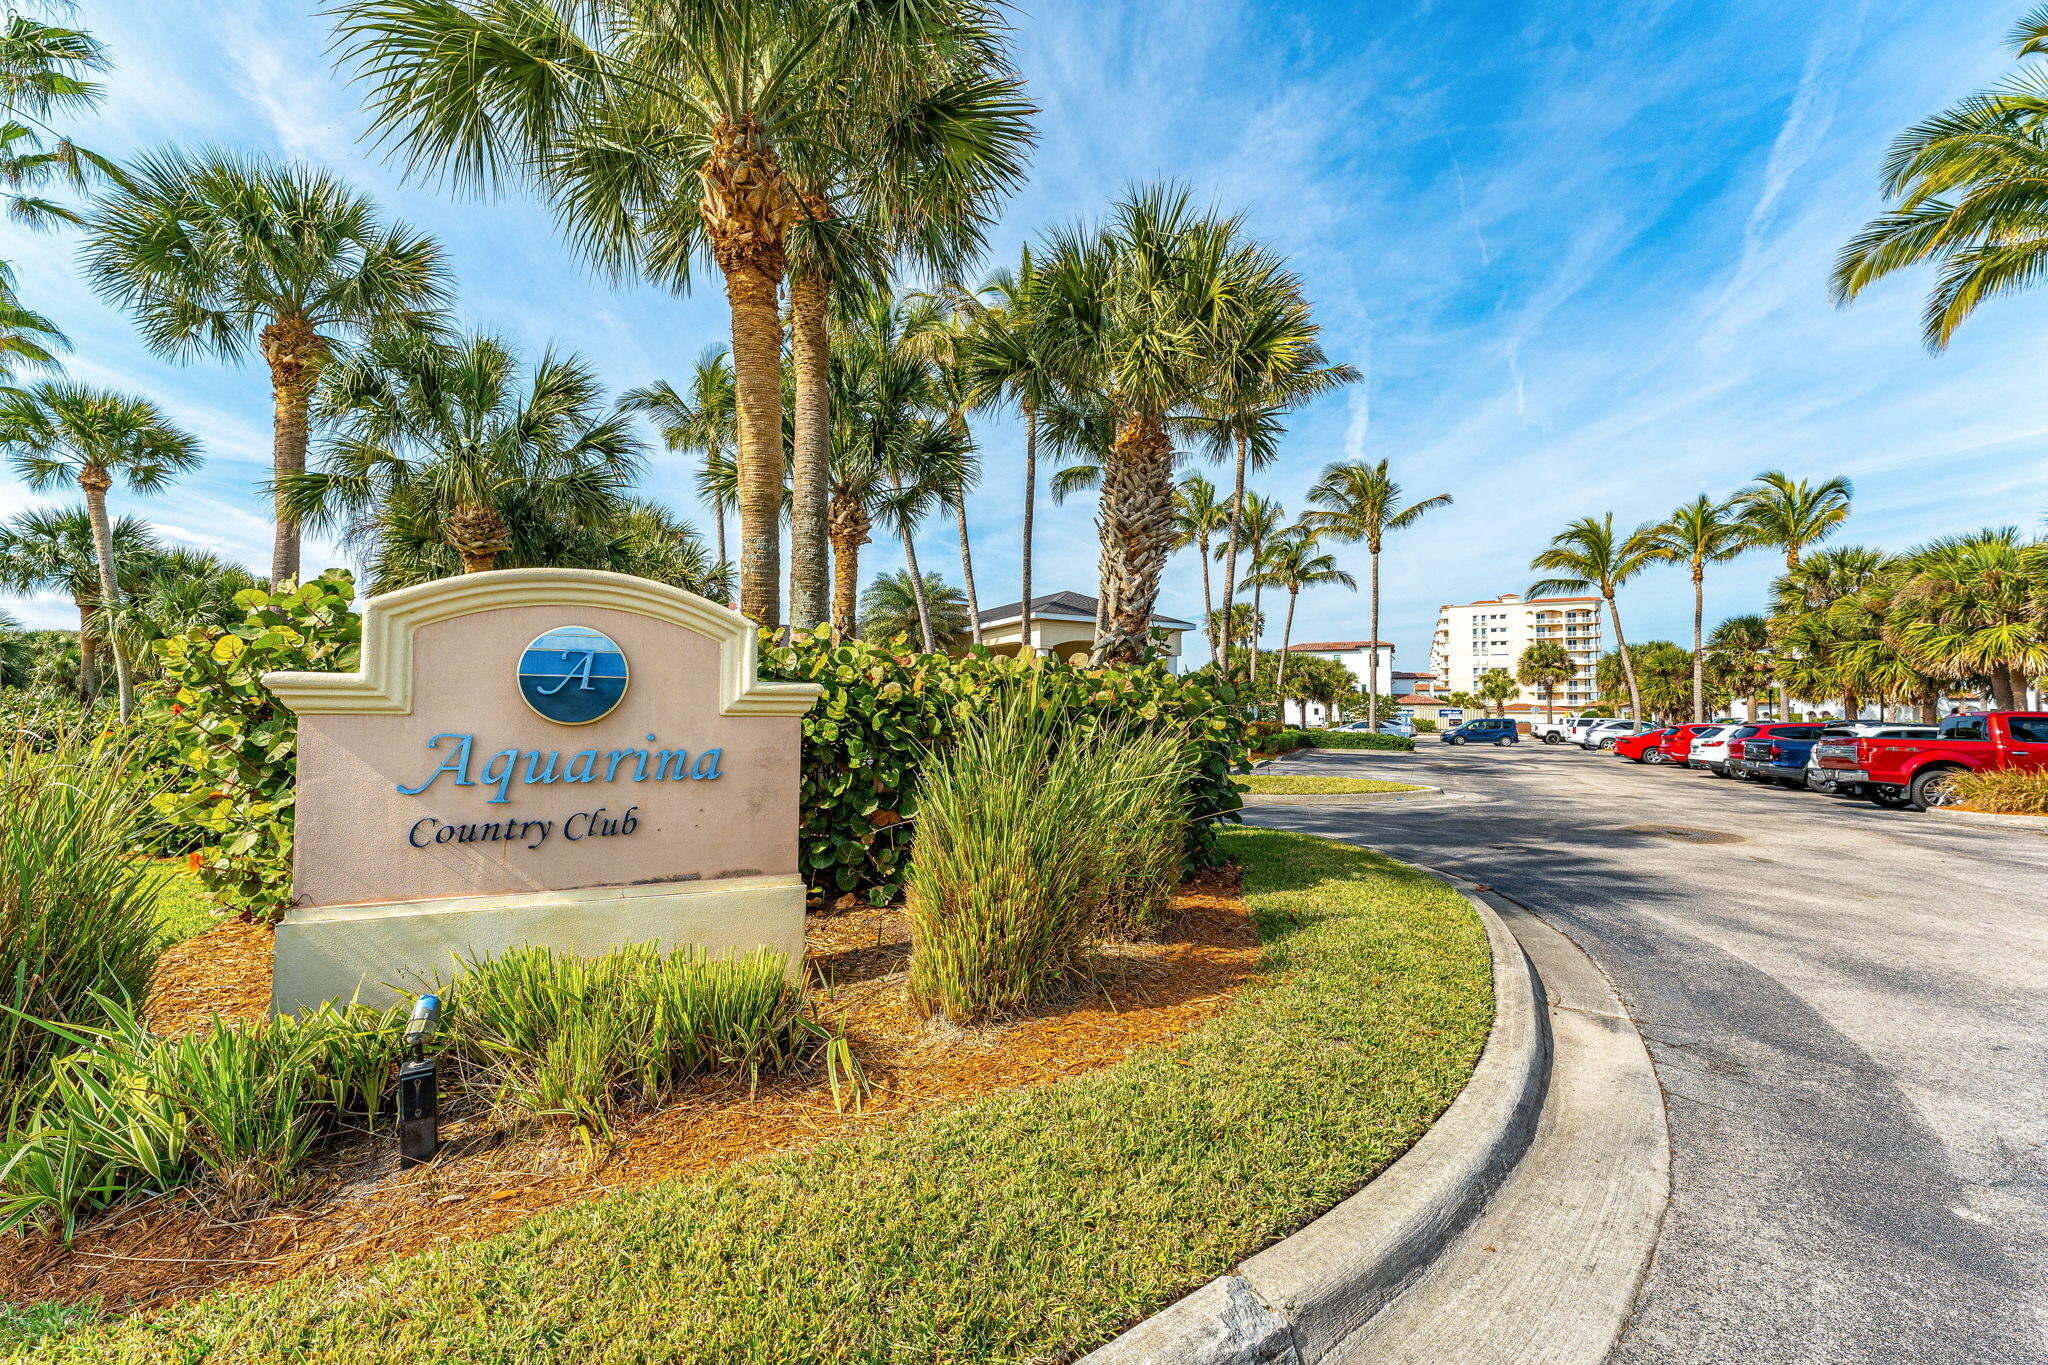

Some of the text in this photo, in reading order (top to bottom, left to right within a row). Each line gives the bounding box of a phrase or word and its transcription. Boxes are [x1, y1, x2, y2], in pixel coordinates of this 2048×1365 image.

[537, 649, 595, 695] A
[396, 733, 725, 804] Aquarina
[409, 806, 639, 850] Country Club
